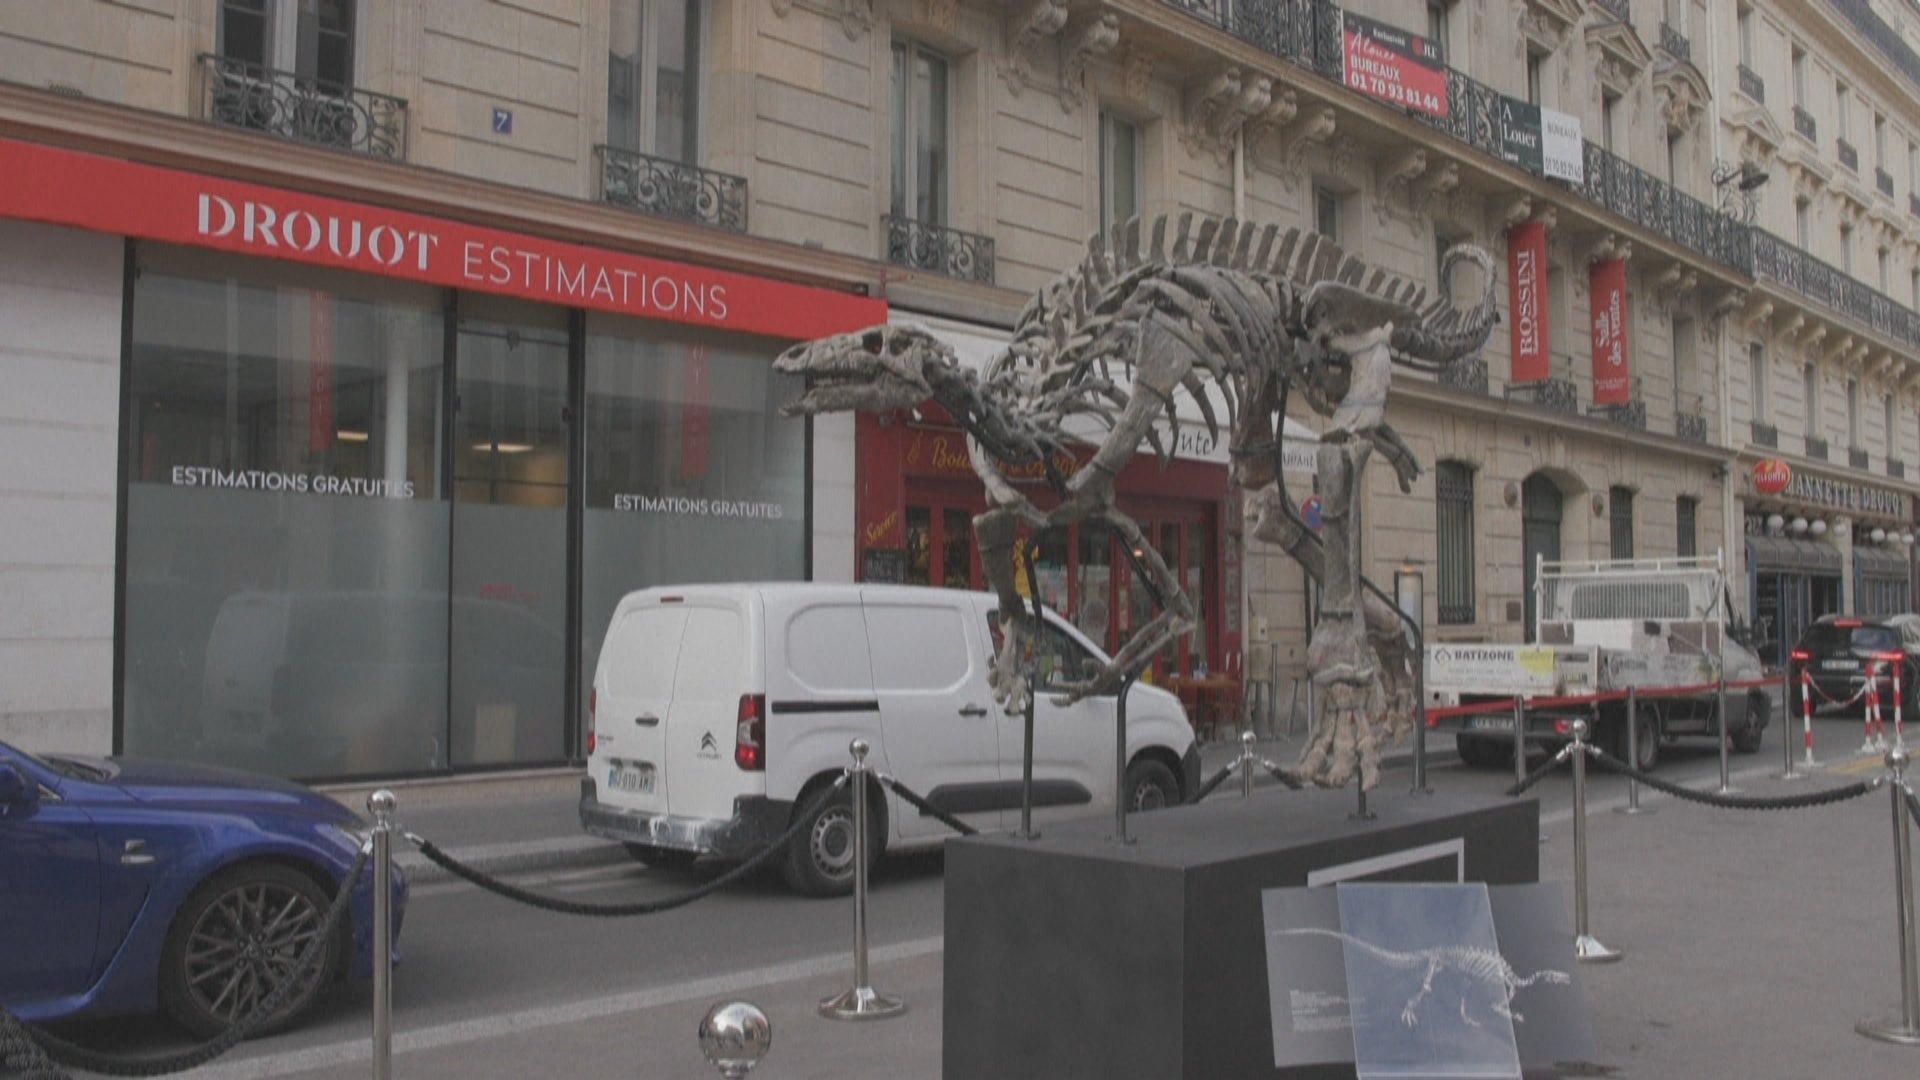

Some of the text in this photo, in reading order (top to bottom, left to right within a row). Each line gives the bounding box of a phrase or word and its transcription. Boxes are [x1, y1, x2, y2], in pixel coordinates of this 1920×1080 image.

[1351, 55, 1401, 82] BUREAUX
[1351, 70, 1367, 91] 01
[1371, 77, 1386, 96] 70
[1424, 94, 1439, 112] 44
[497, 111, 508, 131] 7
[1503, 123, 1537, 149] Louer
[198, 193, 728, 320] DROUOT ESTIMATIONS
[1517, 249, 1533, 357] ROSSINI
[172, 465, 414, 499] ESTIMATIONS GRATUITES
[614, 493, 783, 519] ESTIMATIONS GRATUITES
